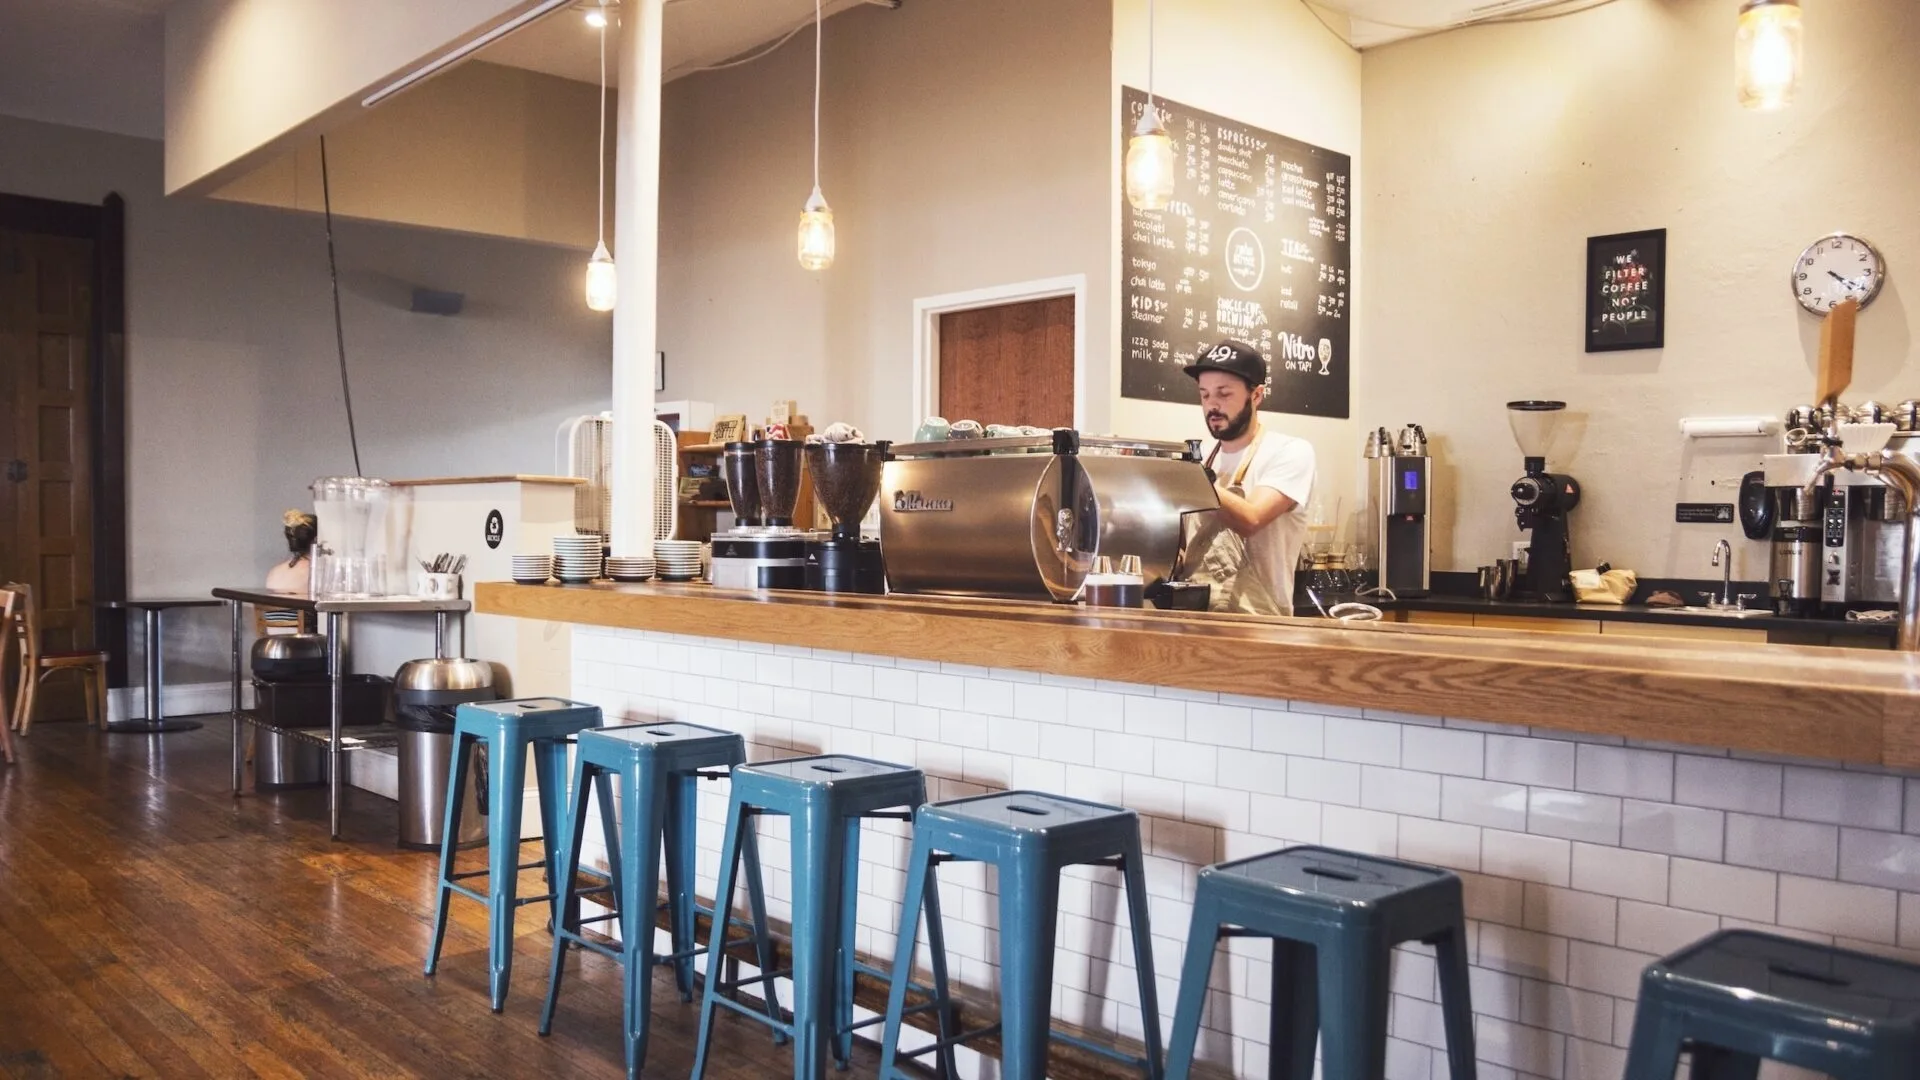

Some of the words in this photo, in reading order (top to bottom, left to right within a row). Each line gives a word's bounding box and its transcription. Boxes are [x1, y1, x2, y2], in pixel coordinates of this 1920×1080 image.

[1217, 127, 1261, 151] ESPRESSO
[1132, 230, 1150, 244] chai
[1831, 241, 1843, 249] 12
[1816, 247, 1823, 255] 11
[1132, 256, 1157, 271] tokyo
[1616, 254, 1633, 264] WE
[1805, 258, 1814, 266] 10
[1859, 254, 1868, 262] 2
[1605, 267, 1645, 279] FILTER
[1799, 272, 1808, 281] 9
[1863, 268, 1872, 277] 3
[1602, 281, 1649, 293] COFFEE
[1803, 287, 1813, 296] 8
[1131, 294, 1160, 312] KIDS
[1612, 296, 1637, 307] NOT
[1813, 297, 1822, 306] 7
[1131, 309, 1165, 324] steamer
[1602, 310, 1647, 322] PEOPLE
[1152, 340, 1169, 351] soda
[1277, 331, 1316, 361] Nitro
[1132, 348, 1152, 361] milk
[1285, 360, 1296, 371] ON
[1297, 361, 1312, 372] TAP!
